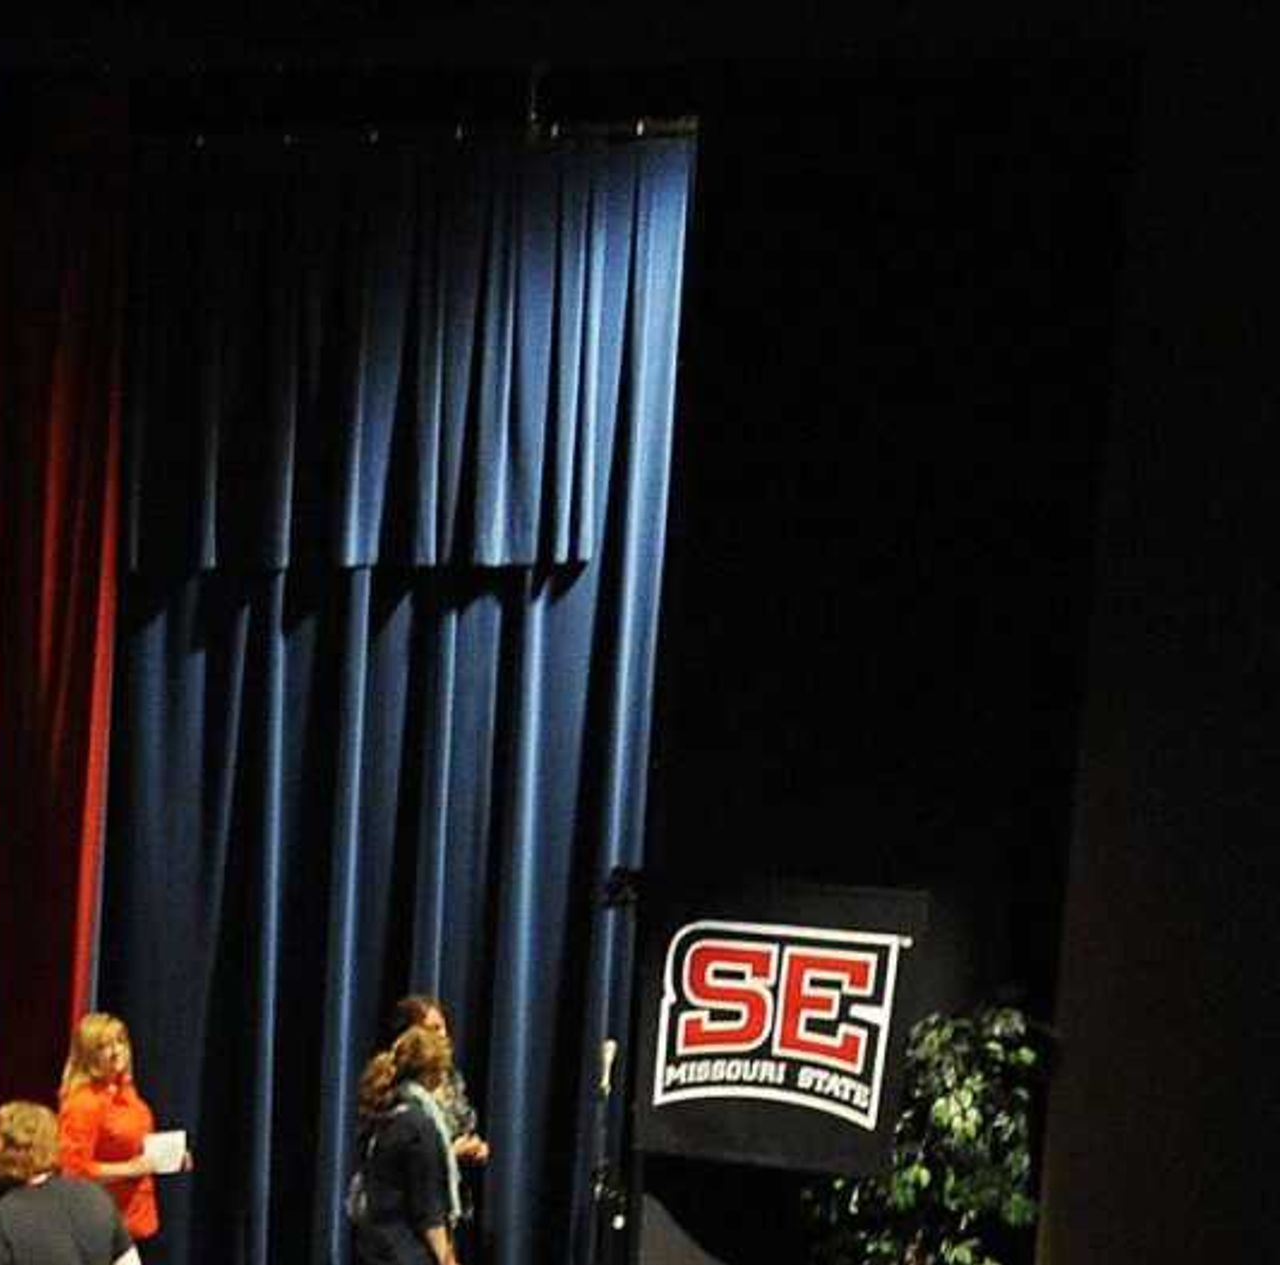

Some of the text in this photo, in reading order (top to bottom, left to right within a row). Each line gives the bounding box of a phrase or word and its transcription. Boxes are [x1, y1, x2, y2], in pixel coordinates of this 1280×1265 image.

[676, 938, 878, 1074] SE
[665, 1058, 871, 1108] MISSOURI STATE
